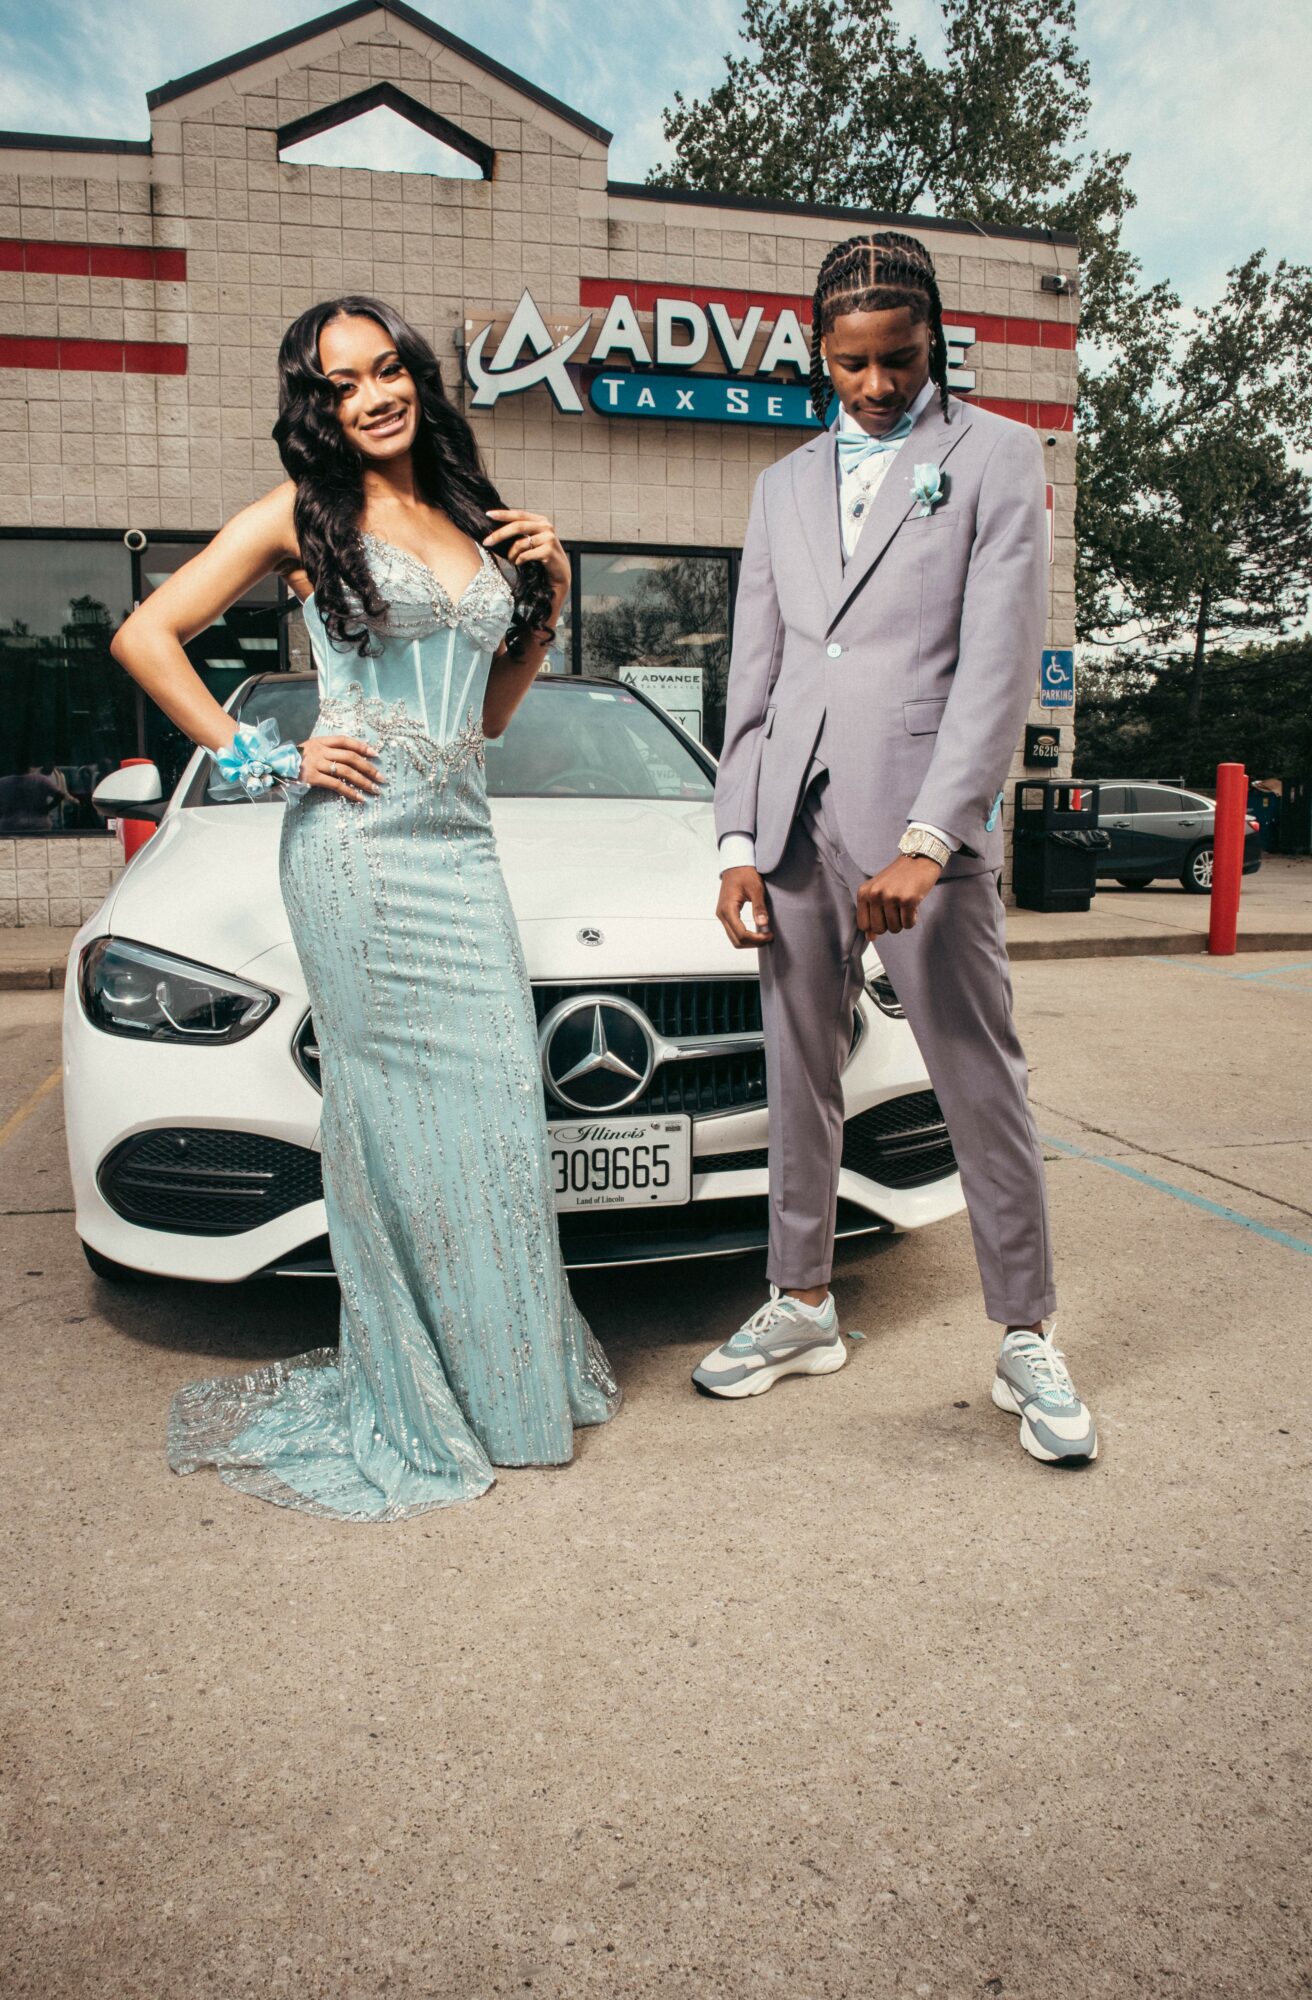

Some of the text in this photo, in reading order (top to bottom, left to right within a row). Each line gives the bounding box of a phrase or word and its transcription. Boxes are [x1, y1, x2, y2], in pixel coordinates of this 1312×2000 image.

[590, 294, 977, 393] ADVAE
[641, 674, 700, 683] ADVANCE
[1041, 689, 1073, 701] PARKING
[1033, 744, 1059, 757] 26219
[554, 1124, 646, 1143] Illinois
[551, 1144, 670, 1193] 309665
[576, 1197, 592, 1205] Land
[602, 1195, 625, 1204] Lincoln
